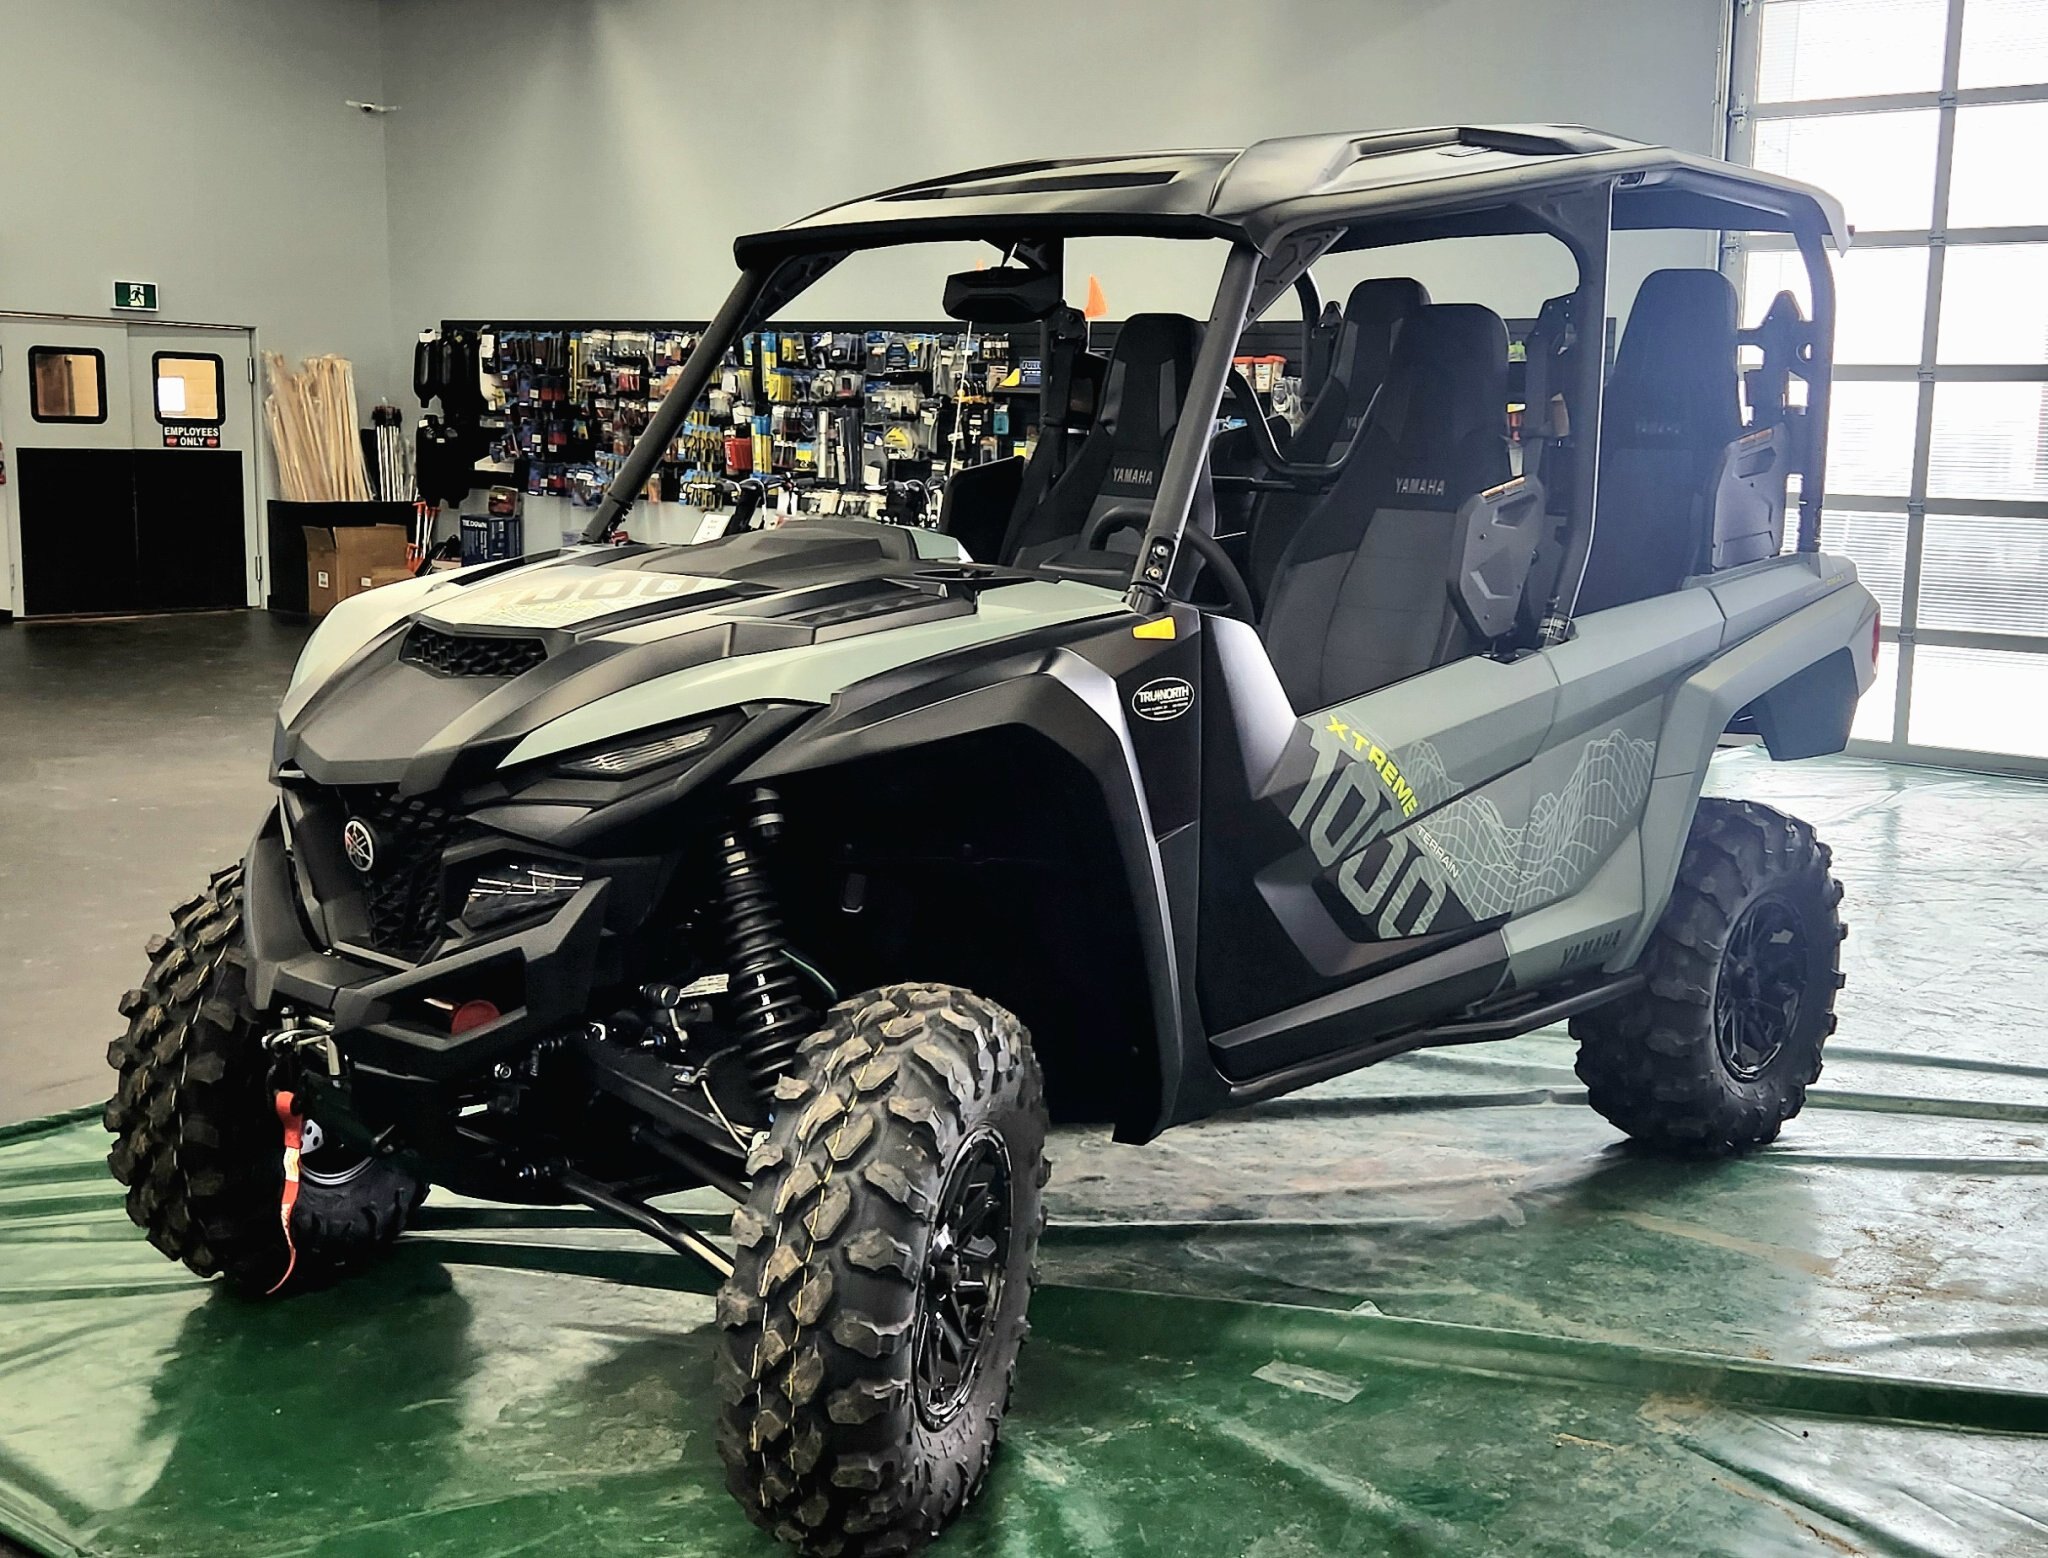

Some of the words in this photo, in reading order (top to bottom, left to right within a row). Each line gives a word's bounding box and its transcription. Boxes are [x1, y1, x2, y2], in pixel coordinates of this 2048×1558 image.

[164, 426, 219, 437] EMPLOYEES
[180, 436, 204, 446] ONLY
[1112, 466, 1153, 485] YAMAHA
[1396, 477, 1445, 496] YAMAHA
[1325, 714, 1418, 818] XTREME
[1288, 718, 1448, 940] 1000
[1417, 824, 1459, 878] TERRAIN
[1560, 929, 1621, 969] YAMAHA
